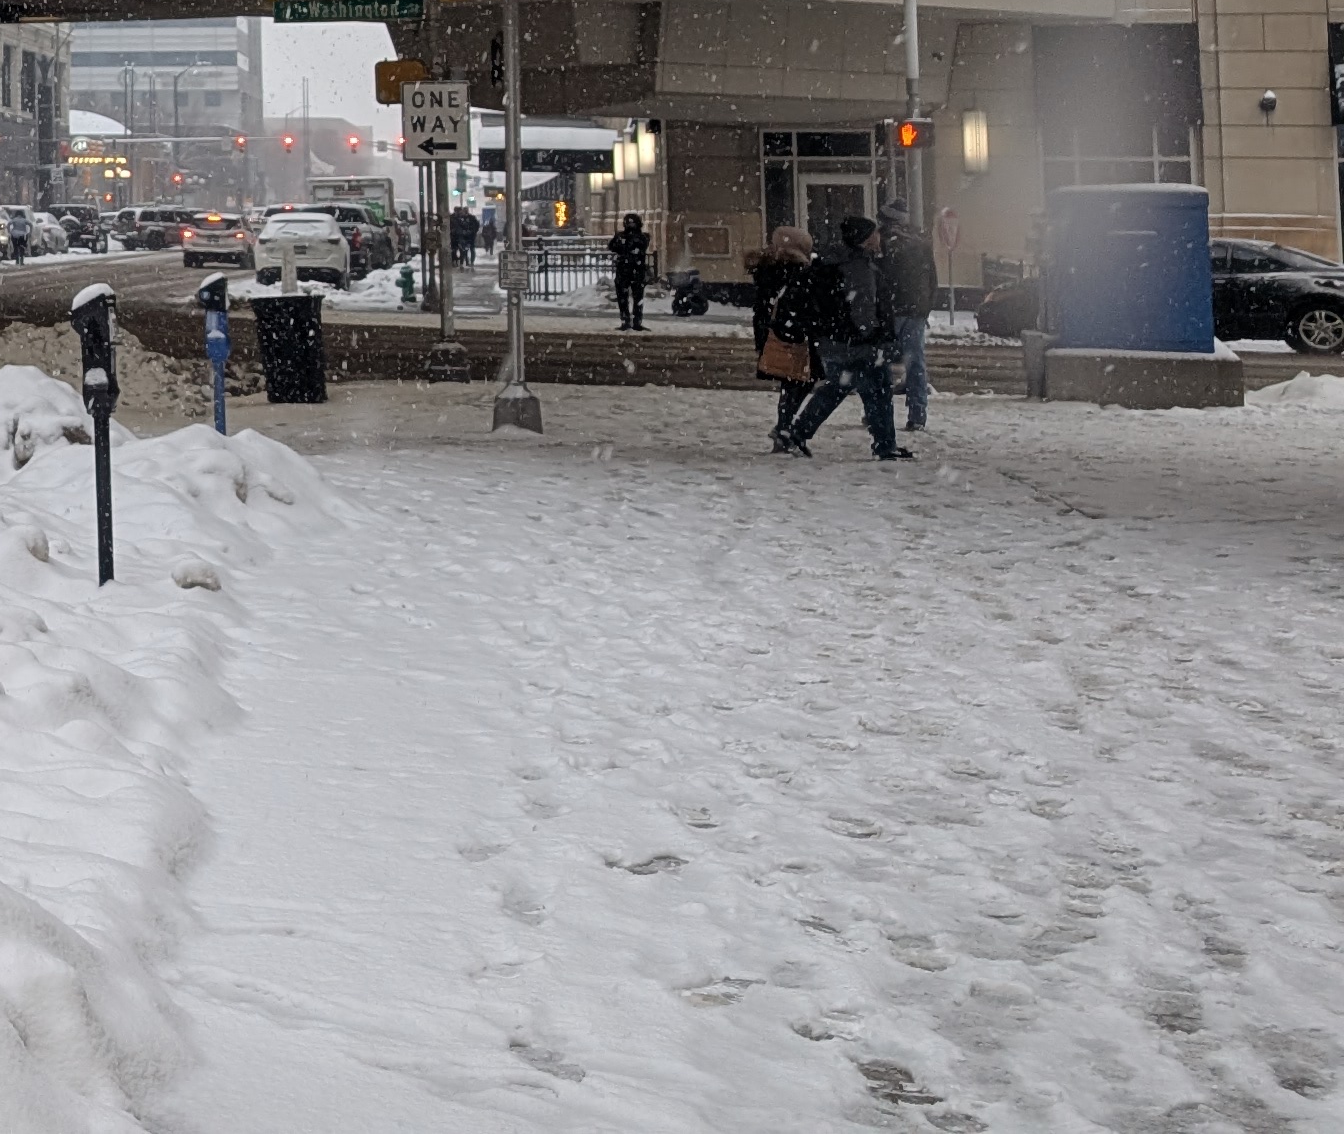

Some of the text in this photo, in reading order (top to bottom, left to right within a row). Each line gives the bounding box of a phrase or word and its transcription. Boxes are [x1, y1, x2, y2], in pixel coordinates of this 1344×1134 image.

[309, 1, 399, 18] Washington
[412, 91, 460, 108] ONE
[411, 115, 463, 133] WAY
